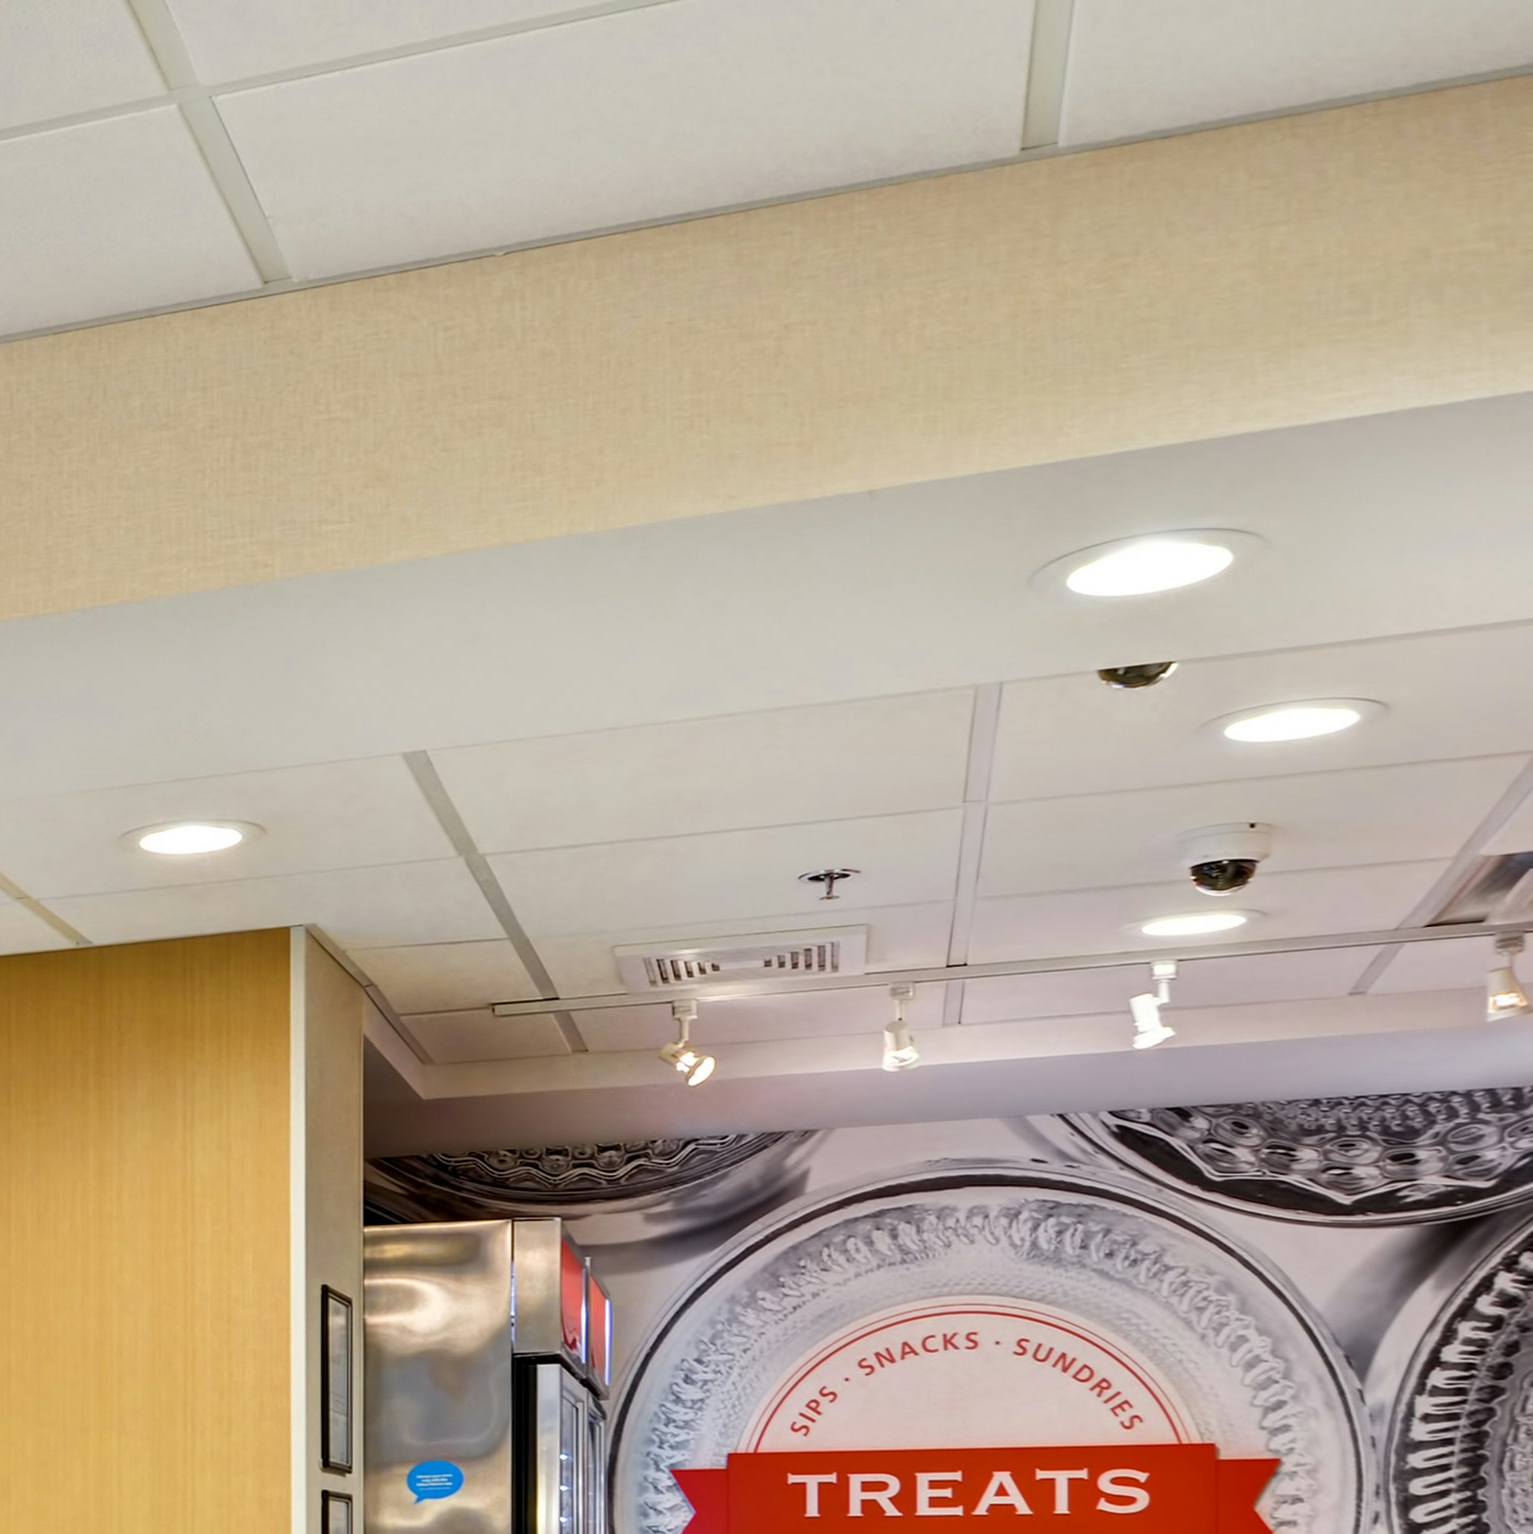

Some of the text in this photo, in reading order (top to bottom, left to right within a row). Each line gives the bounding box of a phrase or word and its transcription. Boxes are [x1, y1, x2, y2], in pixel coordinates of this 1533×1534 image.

[790, 1331, 1144, 1437] SIPS SNACKS SUNDRIES
[787, 1468, 1151, 1517] TREATS
